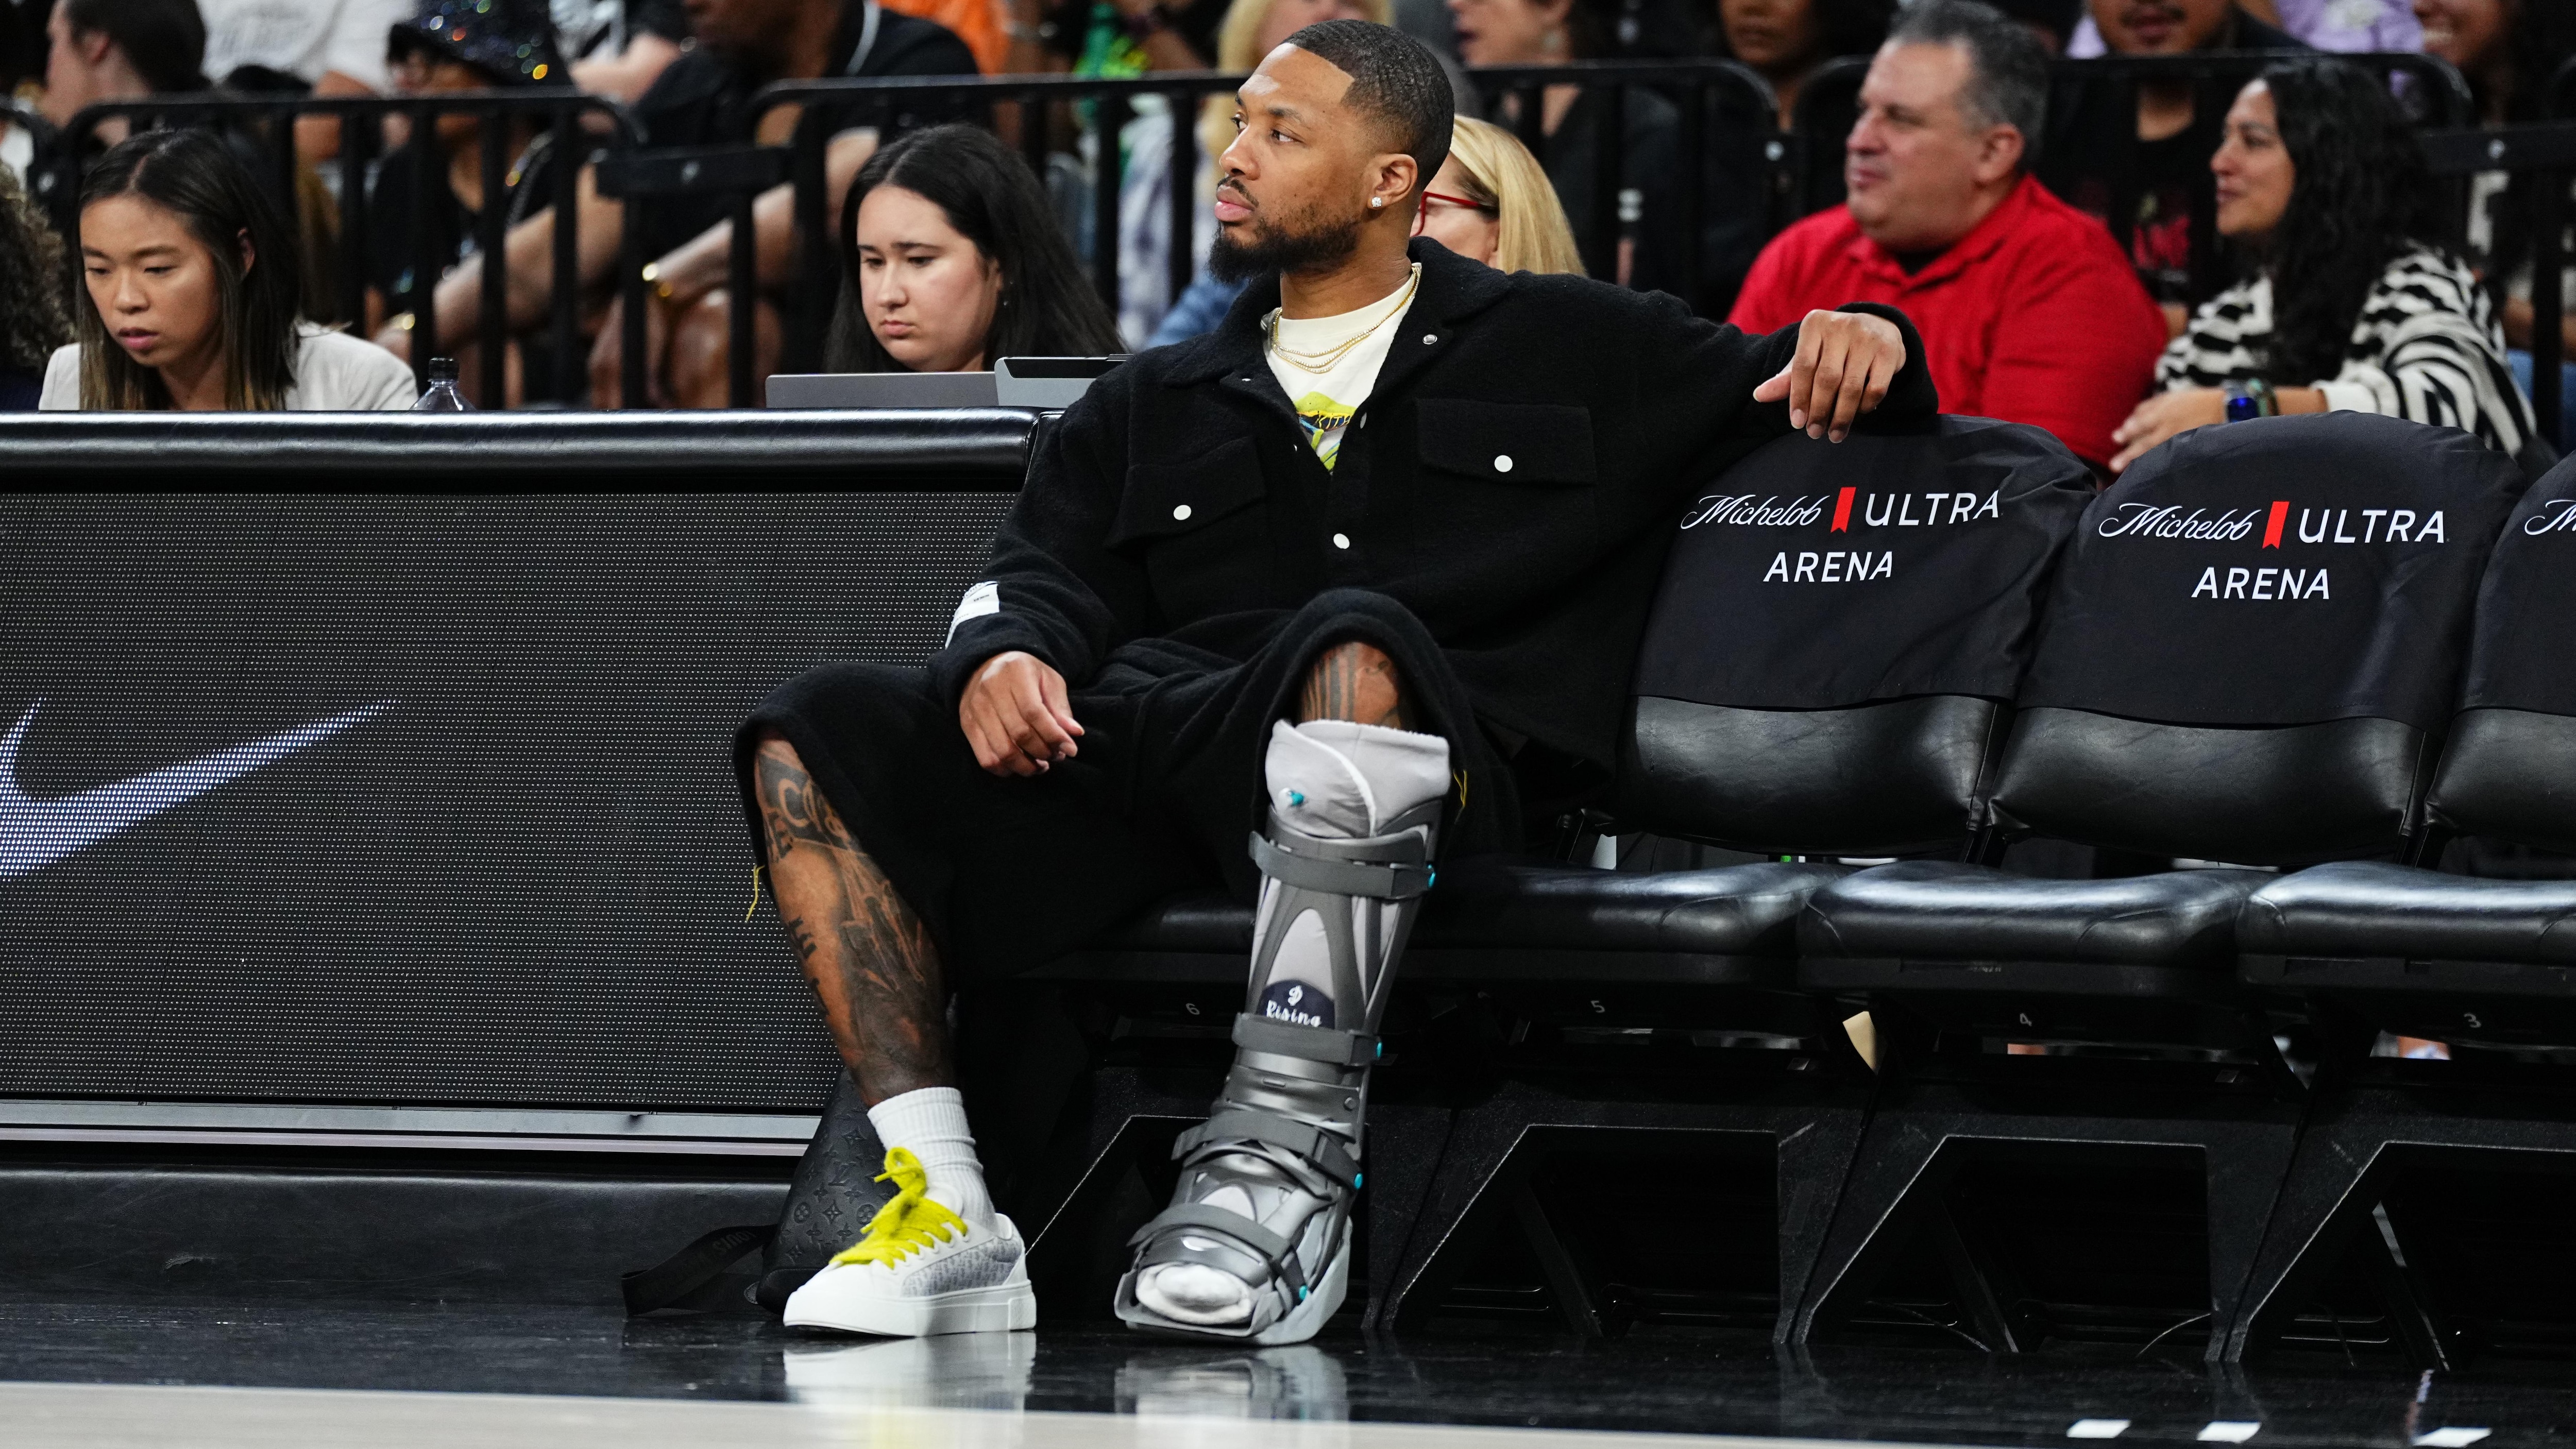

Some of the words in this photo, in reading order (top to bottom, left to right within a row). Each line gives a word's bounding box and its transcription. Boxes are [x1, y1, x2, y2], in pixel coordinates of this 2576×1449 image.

[1680, 494, 1830, 530] Michelob
[1865, 489, 1999, 526] ULTRA
[2098, 503, 2262, 541] Michelob
[2299, 508, 2444, 543] ULTRA
[1762, 551, 1893, 583] ARENA
[2191, 567, 2329, 600] ARENA
[1185, 1003, 1200, 1015] 6
[1591, 1000, 1605, 1013] 5
[2020, 1013, 2032, 1026] 4
[2464, 1013, 2481, 1028] 3
